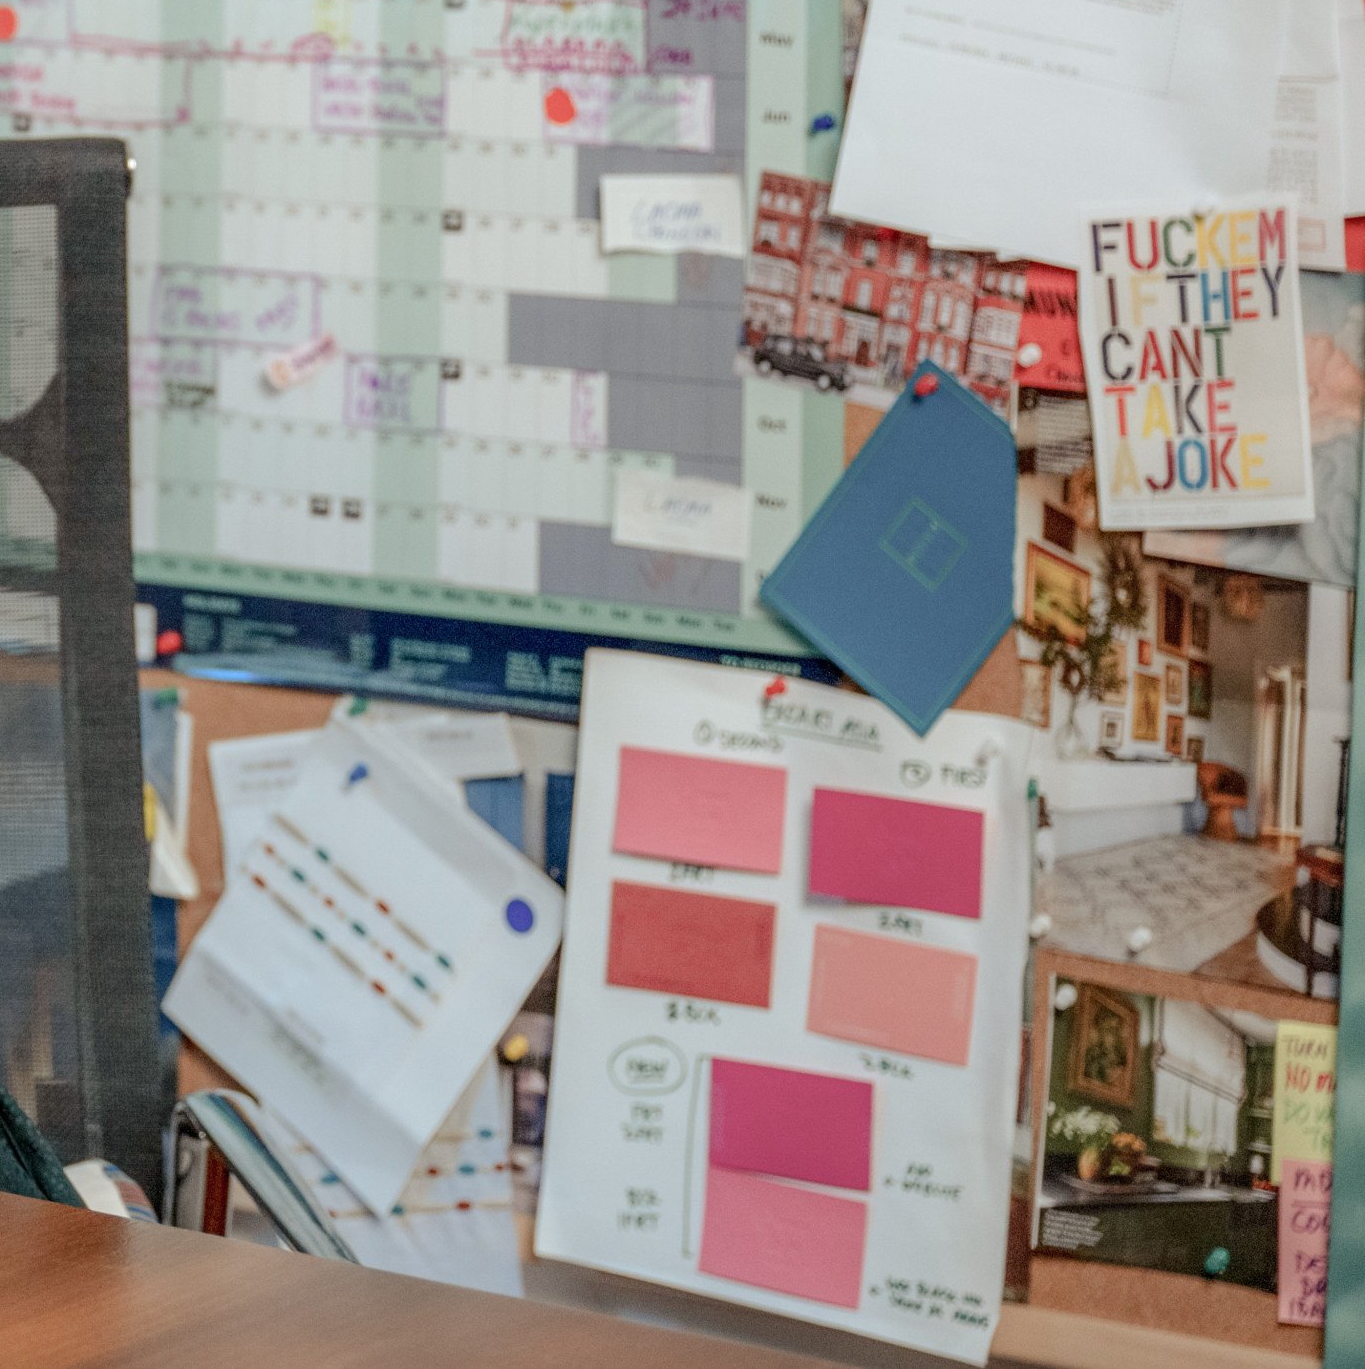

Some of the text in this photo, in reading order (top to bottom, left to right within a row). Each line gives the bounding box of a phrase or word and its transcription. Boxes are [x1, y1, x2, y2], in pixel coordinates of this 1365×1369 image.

[1105, 264, 1285, 327] IF THEY
[1100, 326, 1233, 382] CANT
[1103, 379, 1238, 439] TAKE
[1111, 433, 1272, 494] A JOKE
